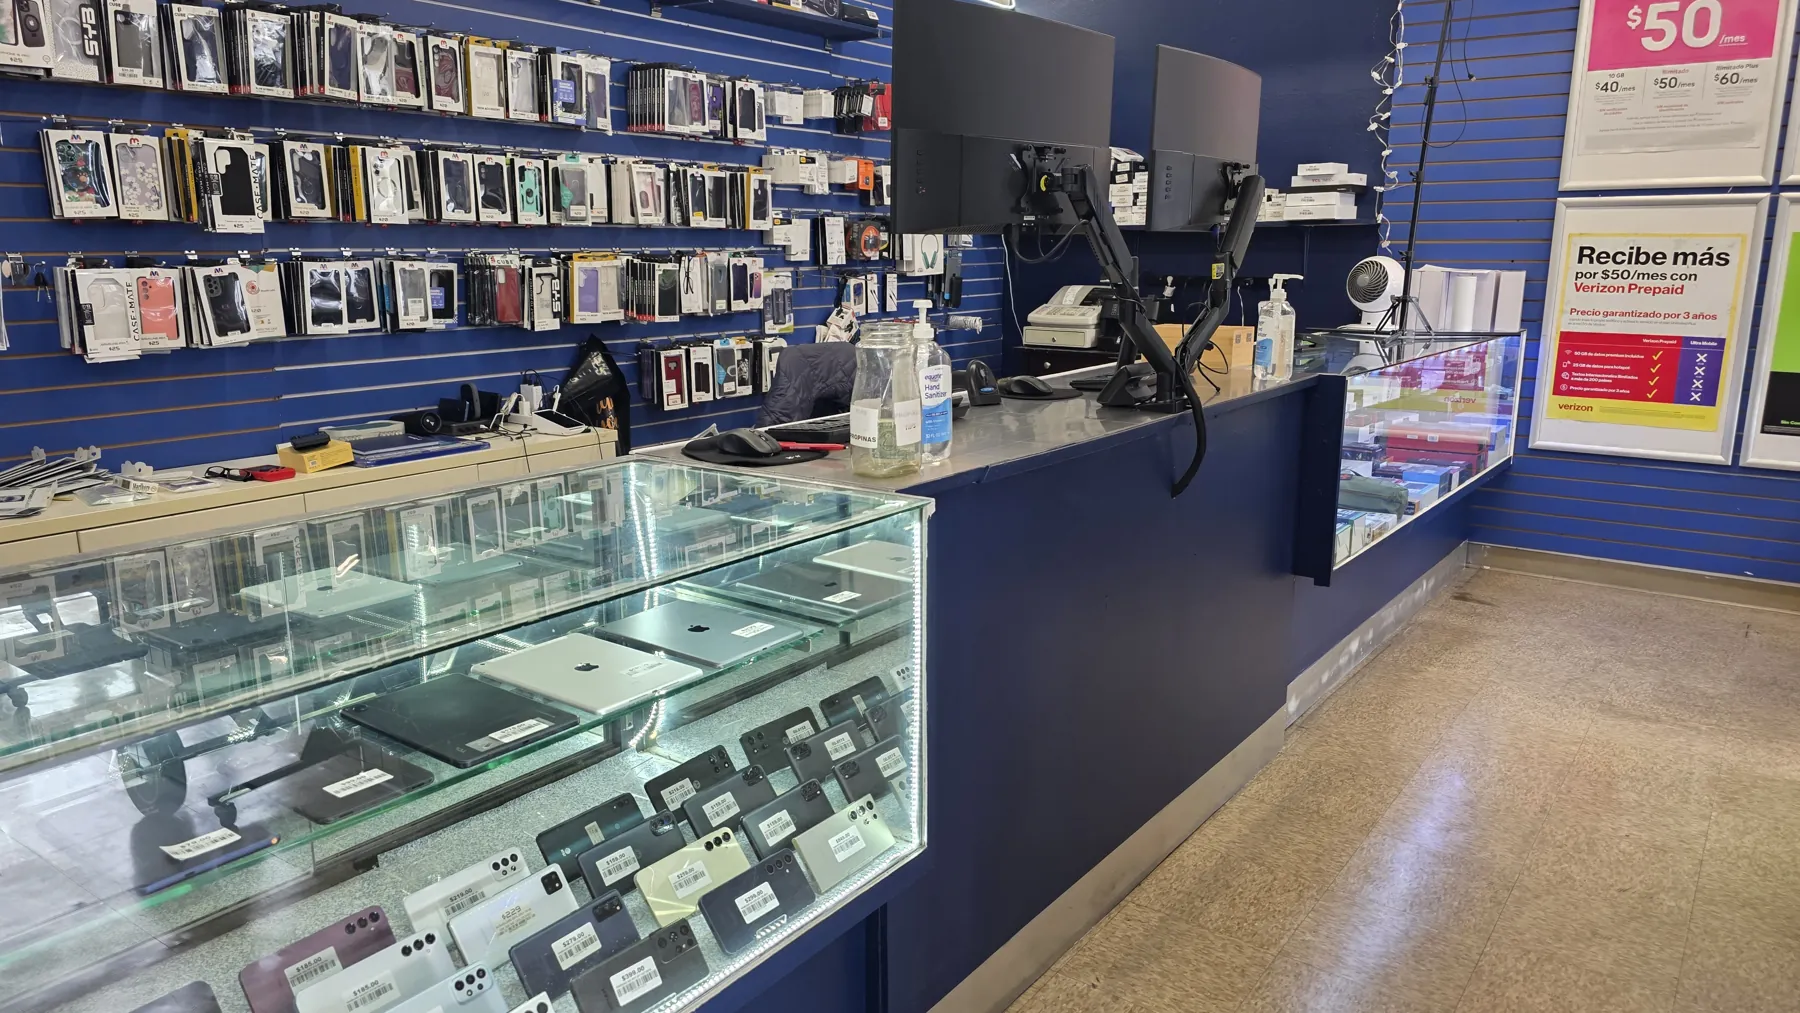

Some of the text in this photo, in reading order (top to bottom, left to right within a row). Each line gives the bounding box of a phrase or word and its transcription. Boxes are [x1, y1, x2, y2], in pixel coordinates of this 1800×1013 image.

[1577, 246, 1730, 266] Recibe más
[1574, 269, 1698, 282] por $50/mes con
[552, 278, 560, 312] SYB
[1574, 282, 1684, 296] Verizon Prepaid
[1570, 308, 1601, 317] Precio
[1602, 309, 1662, 320] garantizado
[1663, 313, 1682, 321] por
[1691, 312, 1718, 320] años
[924, 392, 947, 400] Sanitizer
[1558, 402, 1593, 412] verizon
[606, 852, 626, 866] $159.00
[450, 887, 474, 902] $219.00
[744, 889, 764, 904] $299.00
[501, 904, 522, 921] $229
[562, 931, 585, 948] $279.00
[295, 956, 323, 974] $185.00
[352, 979, 380, 997] $185.00
